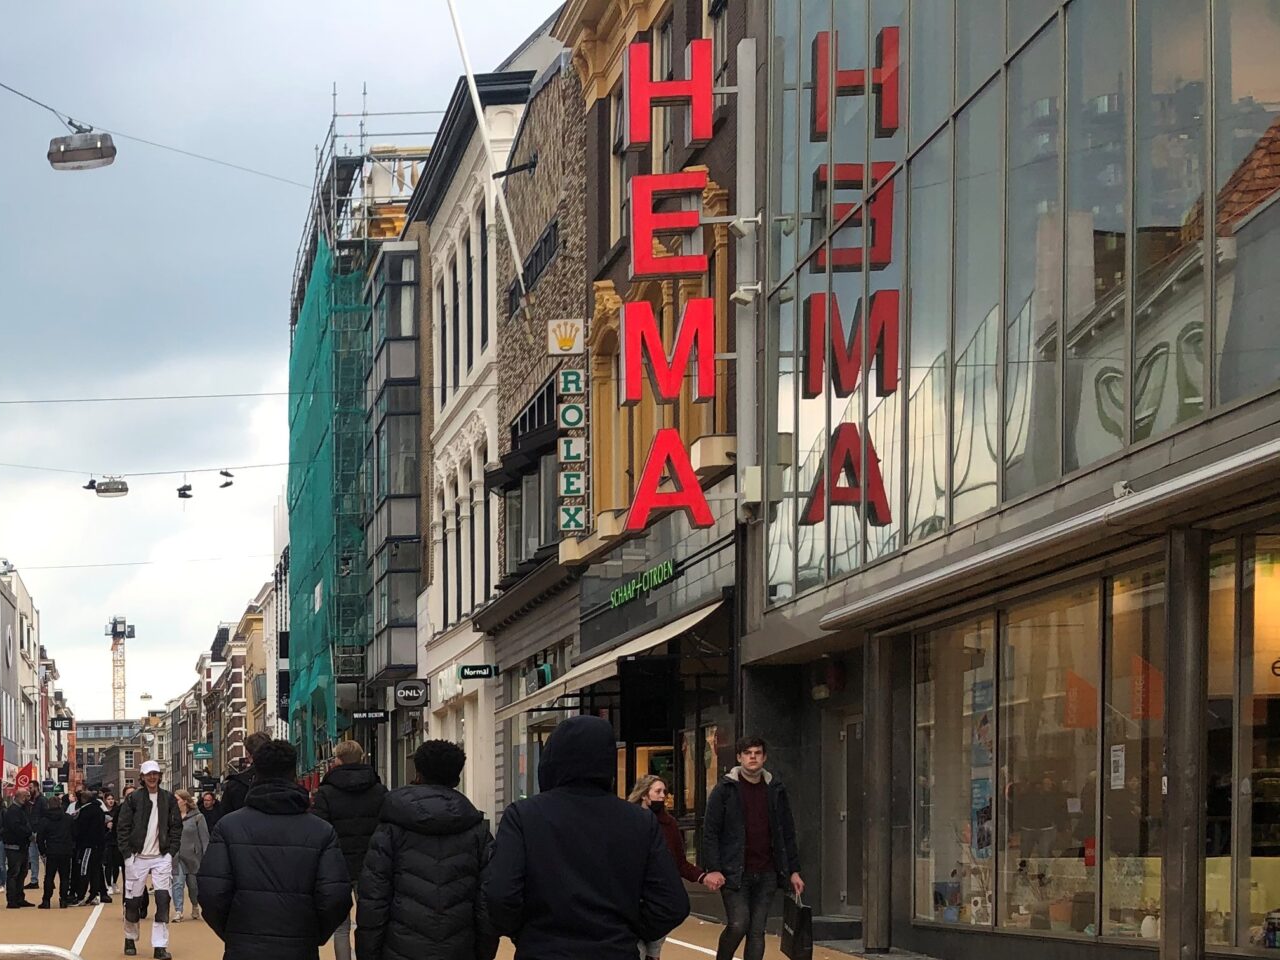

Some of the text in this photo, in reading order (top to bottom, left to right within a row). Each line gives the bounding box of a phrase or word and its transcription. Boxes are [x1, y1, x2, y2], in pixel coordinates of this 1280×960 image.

[622, 38, 714, 530] HEMA
[561, 370, 583, 529] ROLEX
[464, 668, 489, 676] Normal
[397, 689, 425, 697] ONLY
[54, 720, 70, 728] WE
